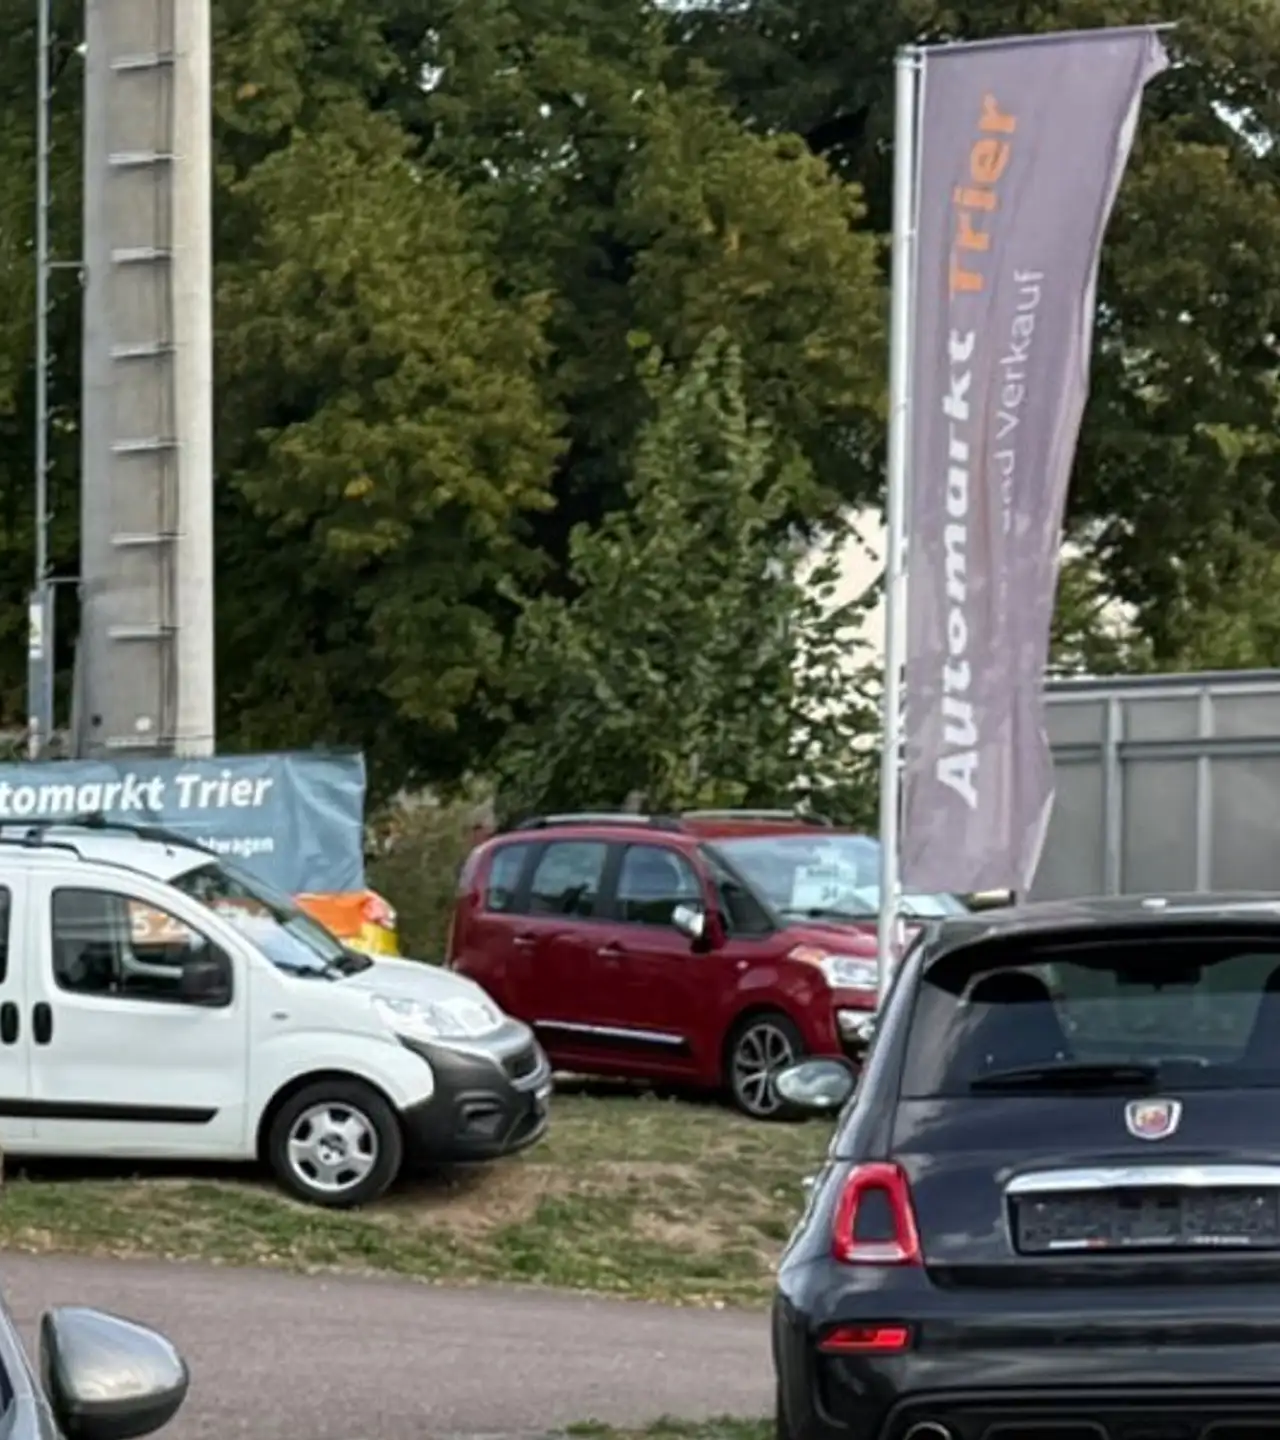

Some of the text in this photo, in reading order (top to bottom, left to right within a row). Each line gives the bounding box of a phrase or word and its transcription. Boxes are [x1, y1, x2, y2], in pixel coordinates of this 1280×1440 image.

[995, 267, 1044, 440] Verkauf
[937, 92, 1017, 809] Automarkt Trier
[174, 769, 274, 809] Trier
